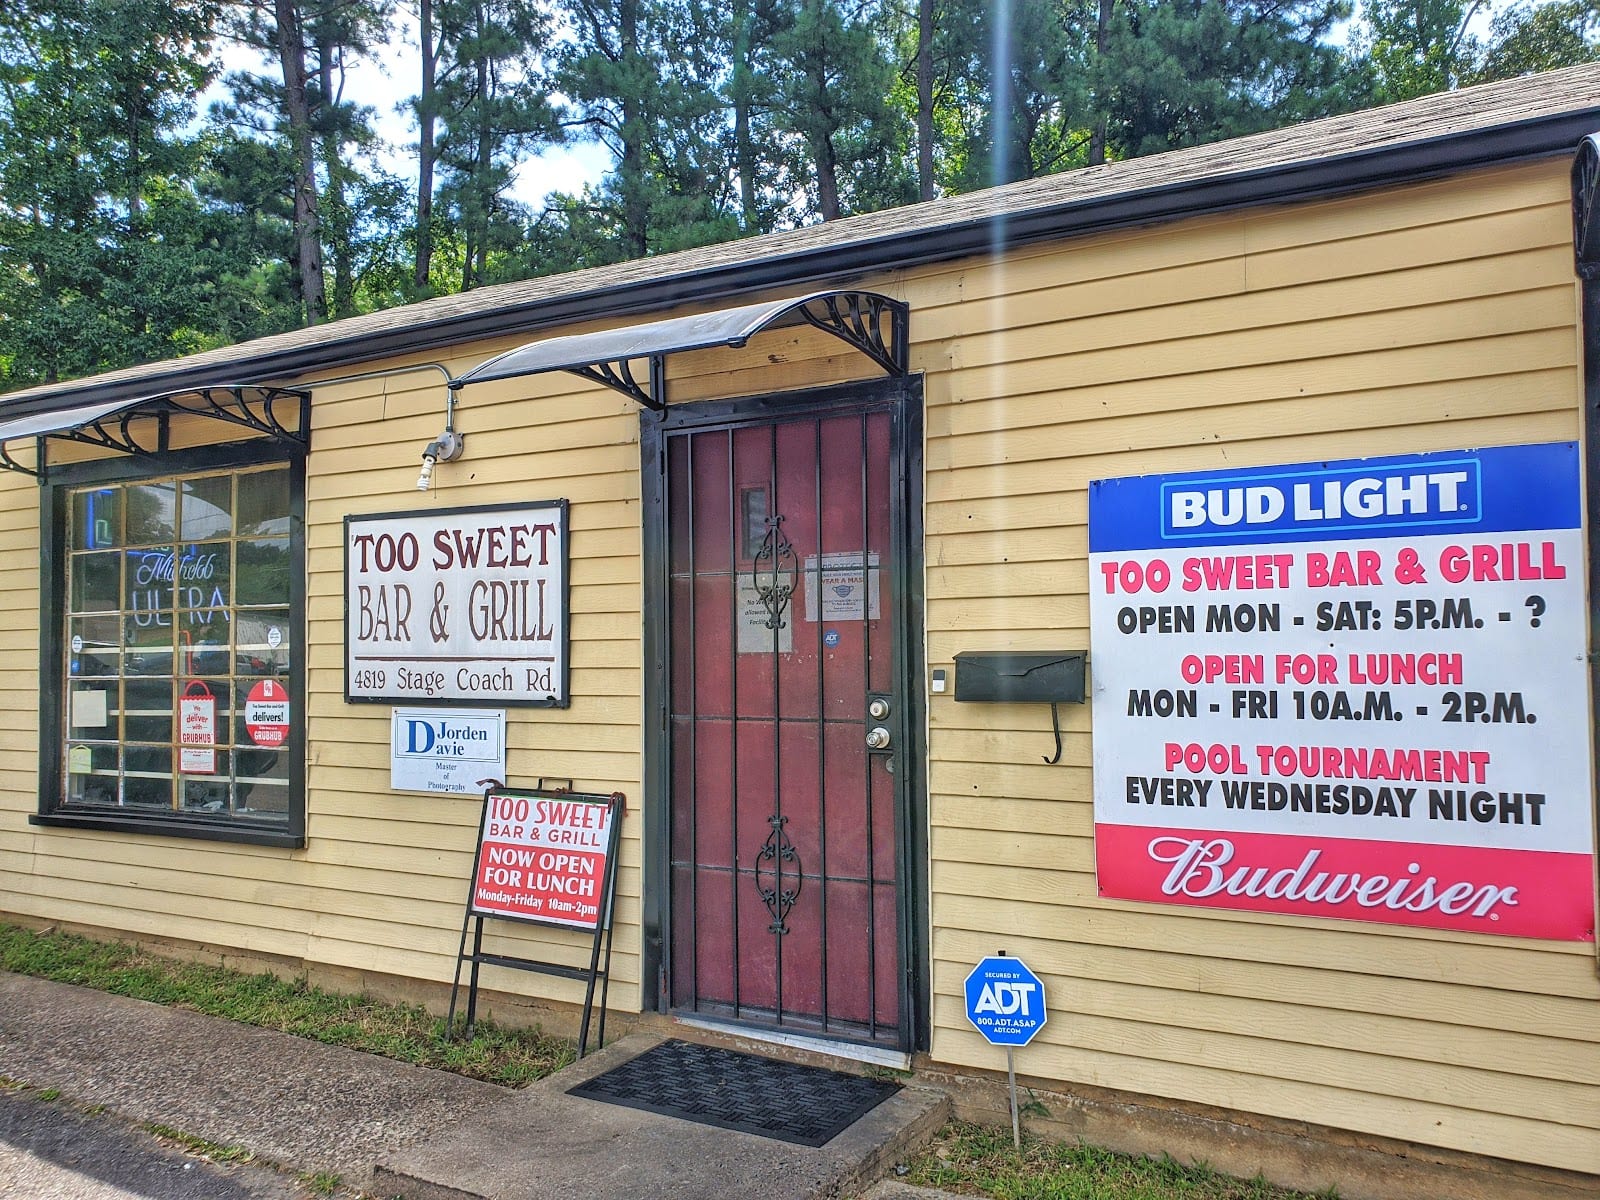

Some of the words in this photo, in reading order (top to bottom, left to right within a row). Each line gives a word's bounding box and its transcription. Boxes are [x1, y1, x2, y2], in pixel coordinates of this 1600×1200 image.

[1171, 486, 1285, 529] BUD
[1294, 471, 1468, 522] LIGHT
[353, 532, 420, 573] TOO
[432, 522, 557, 571] SWEET
[1101, 559, 1171, 595] TOO
[1182, 554, 1294, 593] SWEET
[1306, 550, 1382, 588] BAR
[1395, 547, 1427, 584] &
[1439, 542, 1567, 584] GRILL
[357, 584, 412, 642] BAR
[429, 581, 450, 643] &
[468, 579, 554, 642] GRILL
[1117, 605, 1196, 635] OPEN
[1205, 603, 1281, 633] MON
[1294, 615, 1304, 626] -
[1316, 600, 1382, 631] SAT:
[1393, 598, 1484, 631] 5P.M.
[1498, 611, 1511, 622] -
[1525, 595, 1546, 628] ?
[354, 669, 386, 689] 4819
[396, 667, 445, 696] Stage
[456, 666, 514, 692] Coach
[526, 667, 556, 693] Rd.
[1181, 655, 1264, 685] OPEN
[1276, 654, 1339, 685] FOR
[1349, 653, 1463, 685] LUNCH
[186, 713, 208, 723] deliver
[252, 711, 284, 722] delivers!
[1127, 689, 1197, 718] MON
[1210, 704, 1220, 712] -
[1232, 690, 1278, 719] FRI
[1293, 690, 1403, 722] 10A.M.
[1416, 706, 1428, 716] -
[1441, 691, 1537, 724] 2P.M.
[182, 733, 212, 743] GRUBHUB
[254, 730, 282, 741] GRUBHUB
[437, 722, 487, 741] Jorden
[436, 762, 457, 771] Master
[443, 772, 450, 780] of
[1165, 743, 1248, 775] POOL
[1256, 745, 1490, 784] TOURNAMENT
[428, 781, 466, 792] Photography
[1126, 776, 1213, 808] EVERY
[1221, 780, 1417, 819] WEDNESDAY
[1429, 789, 1546, 826] NIGHT
[490, 796, 530, 822] TOO
[534, 801, 609, 830] SWEET
[489, 823, 524, 839] BAR
[530, 827, 540, 841] &
[548, 829, 601, 847] GRILL
[488, 847, 536, 868] NOW
[539, 853, 595, 875] OPEN
[484, 867, 522, 888] FOR
[527, 872, 594, 897] LUNCH
[1147, 836, 1519, 917] Budweiser
[477, 887, 543, 910] Monday-Friday
[548, 898, 597, 917] 10am-2pm
[974, 982, 1036, 1016] ADT
[977, 1018, 1036, 1028] 800.ADT.ASAP
